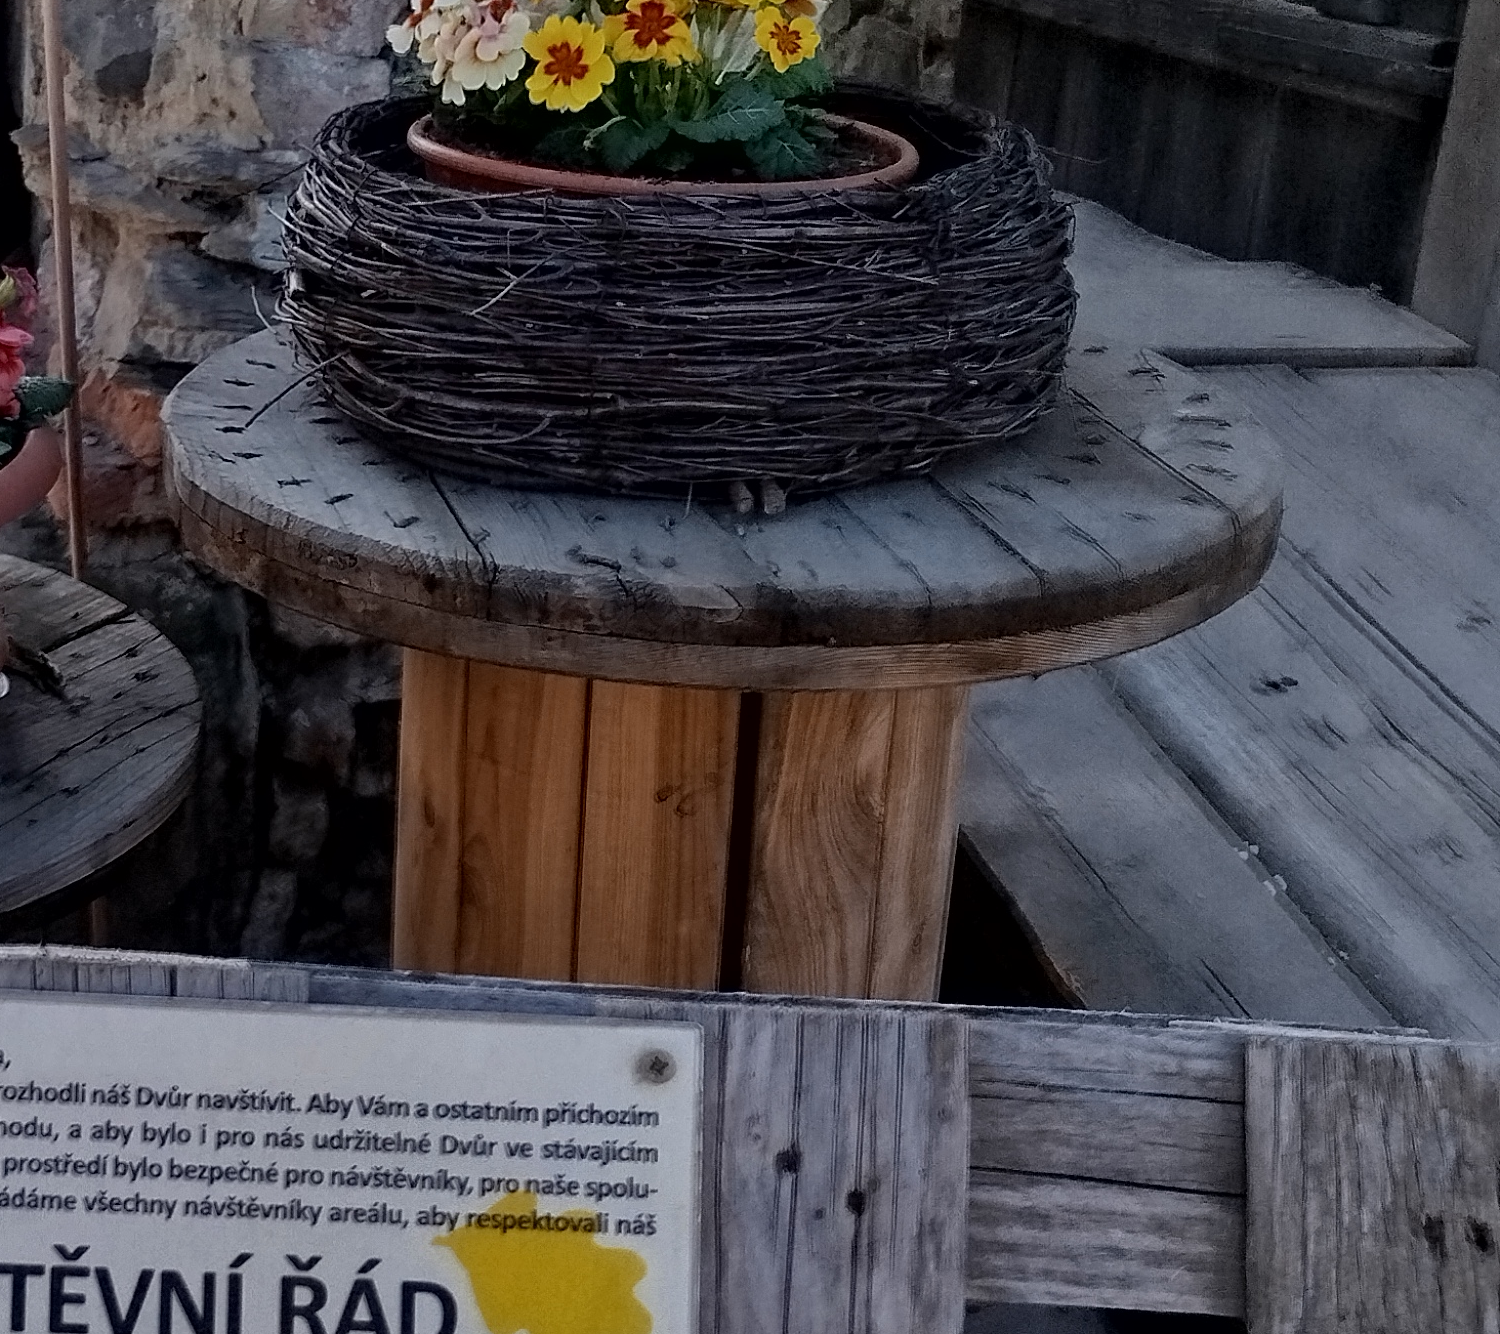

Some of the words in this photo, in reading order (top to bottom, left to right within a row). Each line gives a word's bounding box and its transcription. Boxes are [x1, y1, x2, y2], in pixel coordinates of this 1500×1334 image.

[90, 1082, 131, 1107] náš
[134, 1085, 193, 1109] Dvůr
[195, 1088, 302, 1114] navštívit.
[304, 1092, 354, 1121] Aby
[355, 1094, 410, 1118] Vám
[412, 1102, 429, 1119] a
[432, 1099, 539, 1123] ostatním
[542, 1101, 660, 1129] příchozím
[67, 1123, 82, 1140] a
[89, 1118, 134, 1147] aby
[140, 1120, 192, 1149] bylo
[199, 1123, 208, 1145] i
[214, 1129, 256, 1151] pro
[263, 1125, 305, 1150] nás
[312, 1128, 432, 1155] udržitelné
[439, 1134, 498, 1158] Dvůr
[503, 1141, 534, 1159] ve
[540, 1138, 659, 1167] stávajícím
[1, 1152, 108, 1179] prostředí
[112, 1155, 163, 1183] bylo
[167, 1157, 279, 1187] bezpečné
[283, 1167, 324, 1190] pro
[328, 1164, 473, 1197] návštěvníky,
[478, 1176, 520, 1198] pro
[522, 1173, 580, 1197] naše
[583, 1176, 657, 1203] spolu-
[83, 1190, 177, 1221] všechny
[182, 1195, 322, 1227] návštěvníky
[327, 1202, 409, 1229] areálu,
[415, 1204, 460, 1233] aby
[464, 1209, 609, 1235] respektovali
[614, 1213, 657, 1237] náš
